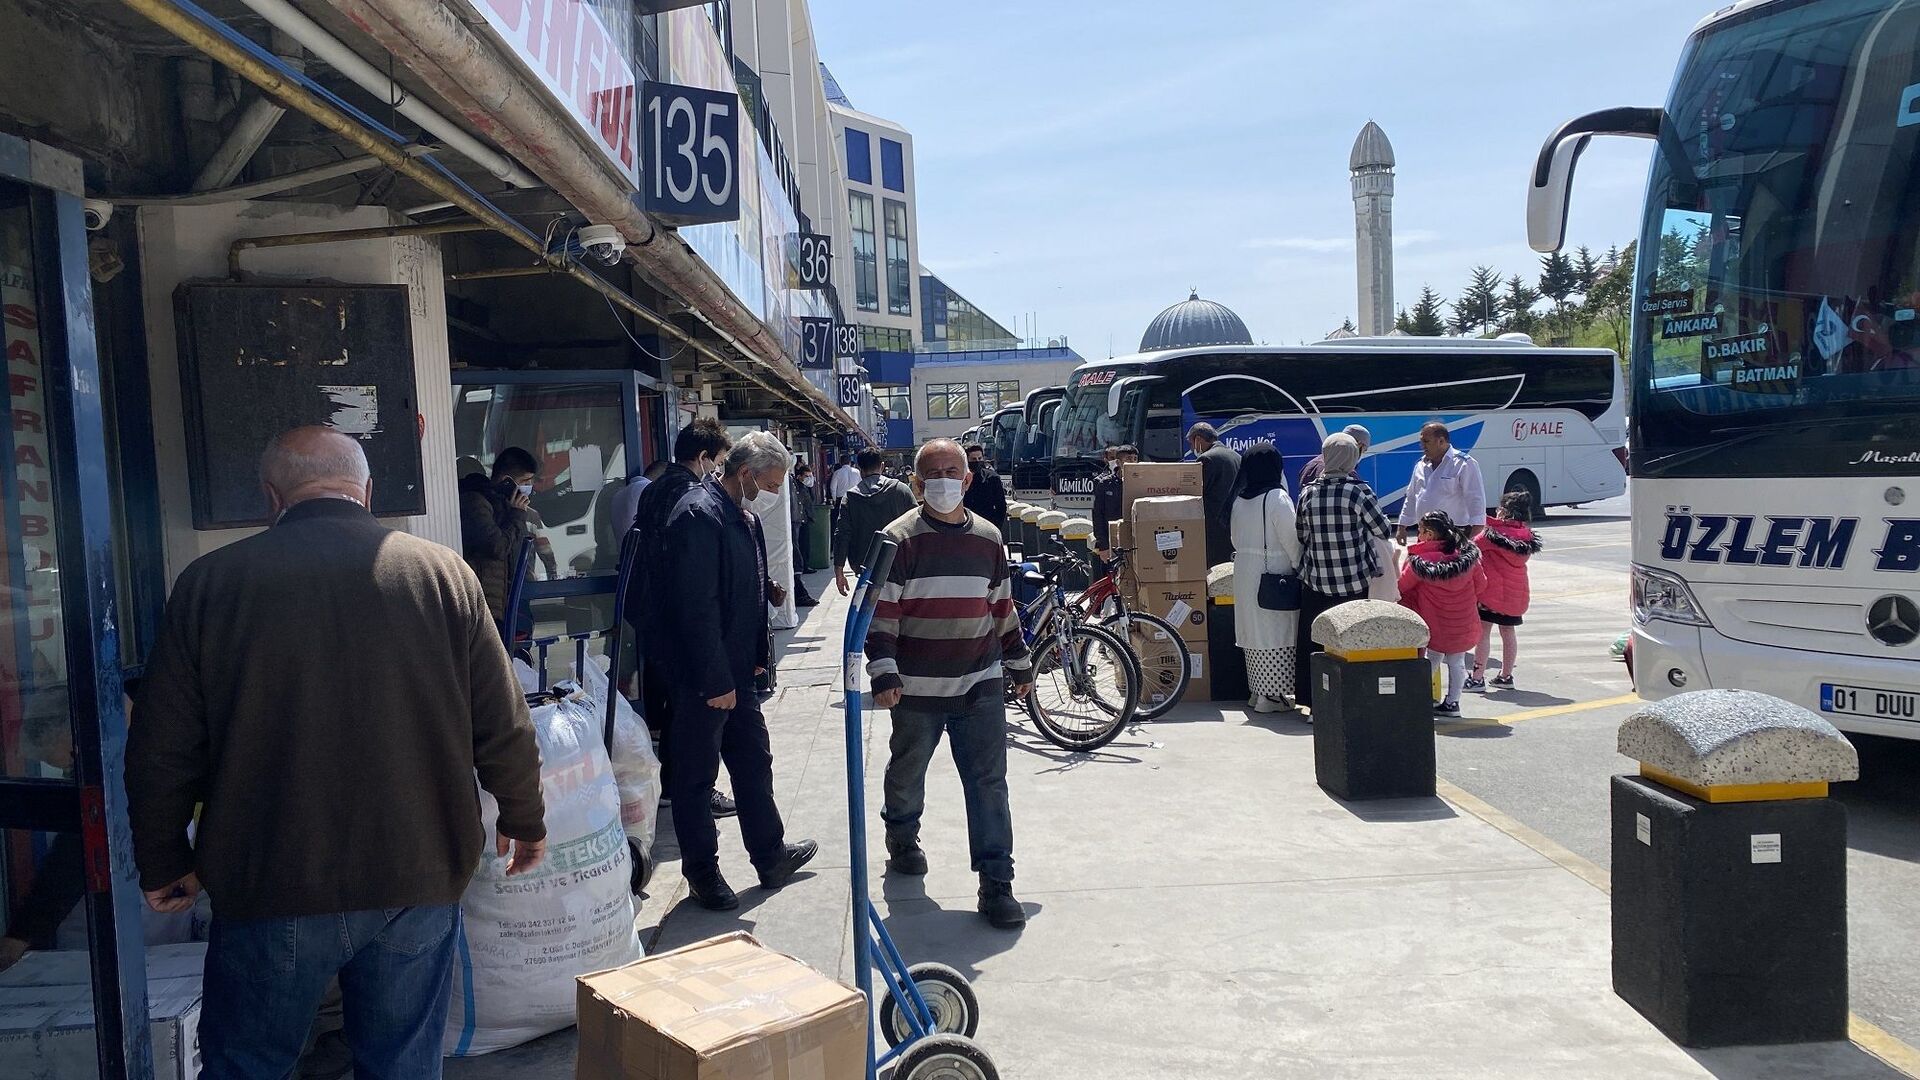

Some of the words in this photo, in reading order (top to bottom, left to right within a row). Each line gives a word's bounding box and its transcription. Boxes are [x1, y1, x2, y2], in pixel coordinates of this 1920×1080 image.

[648, 95, 733, 207] 135
[1661, 297, 1689, 310] Servis
[1664, 316, 1719, 335] ANKARA
[835, 327, 857, 354] 138
[1707, 337, 1767, 359] D.BAKIR
[1078, 370, 1116, 387] KALE
[1735, 365, 1799, 383] BATMAN
[838, 376, 860, 404] 139
[1530, 421, 1563, 435] KALE
[1059, 477, 1095, 493] KÂMİLKO
[1658, 504, 1861, 570] ÖZLEM
[1192, 613, 1202, 622] 50
[1834, 688, 1857, 711] 01
[1875, 693, 1915, 717] DUU
[572, 861, 613, 884] Ticaret
[528, 919, 541, 929] 342
